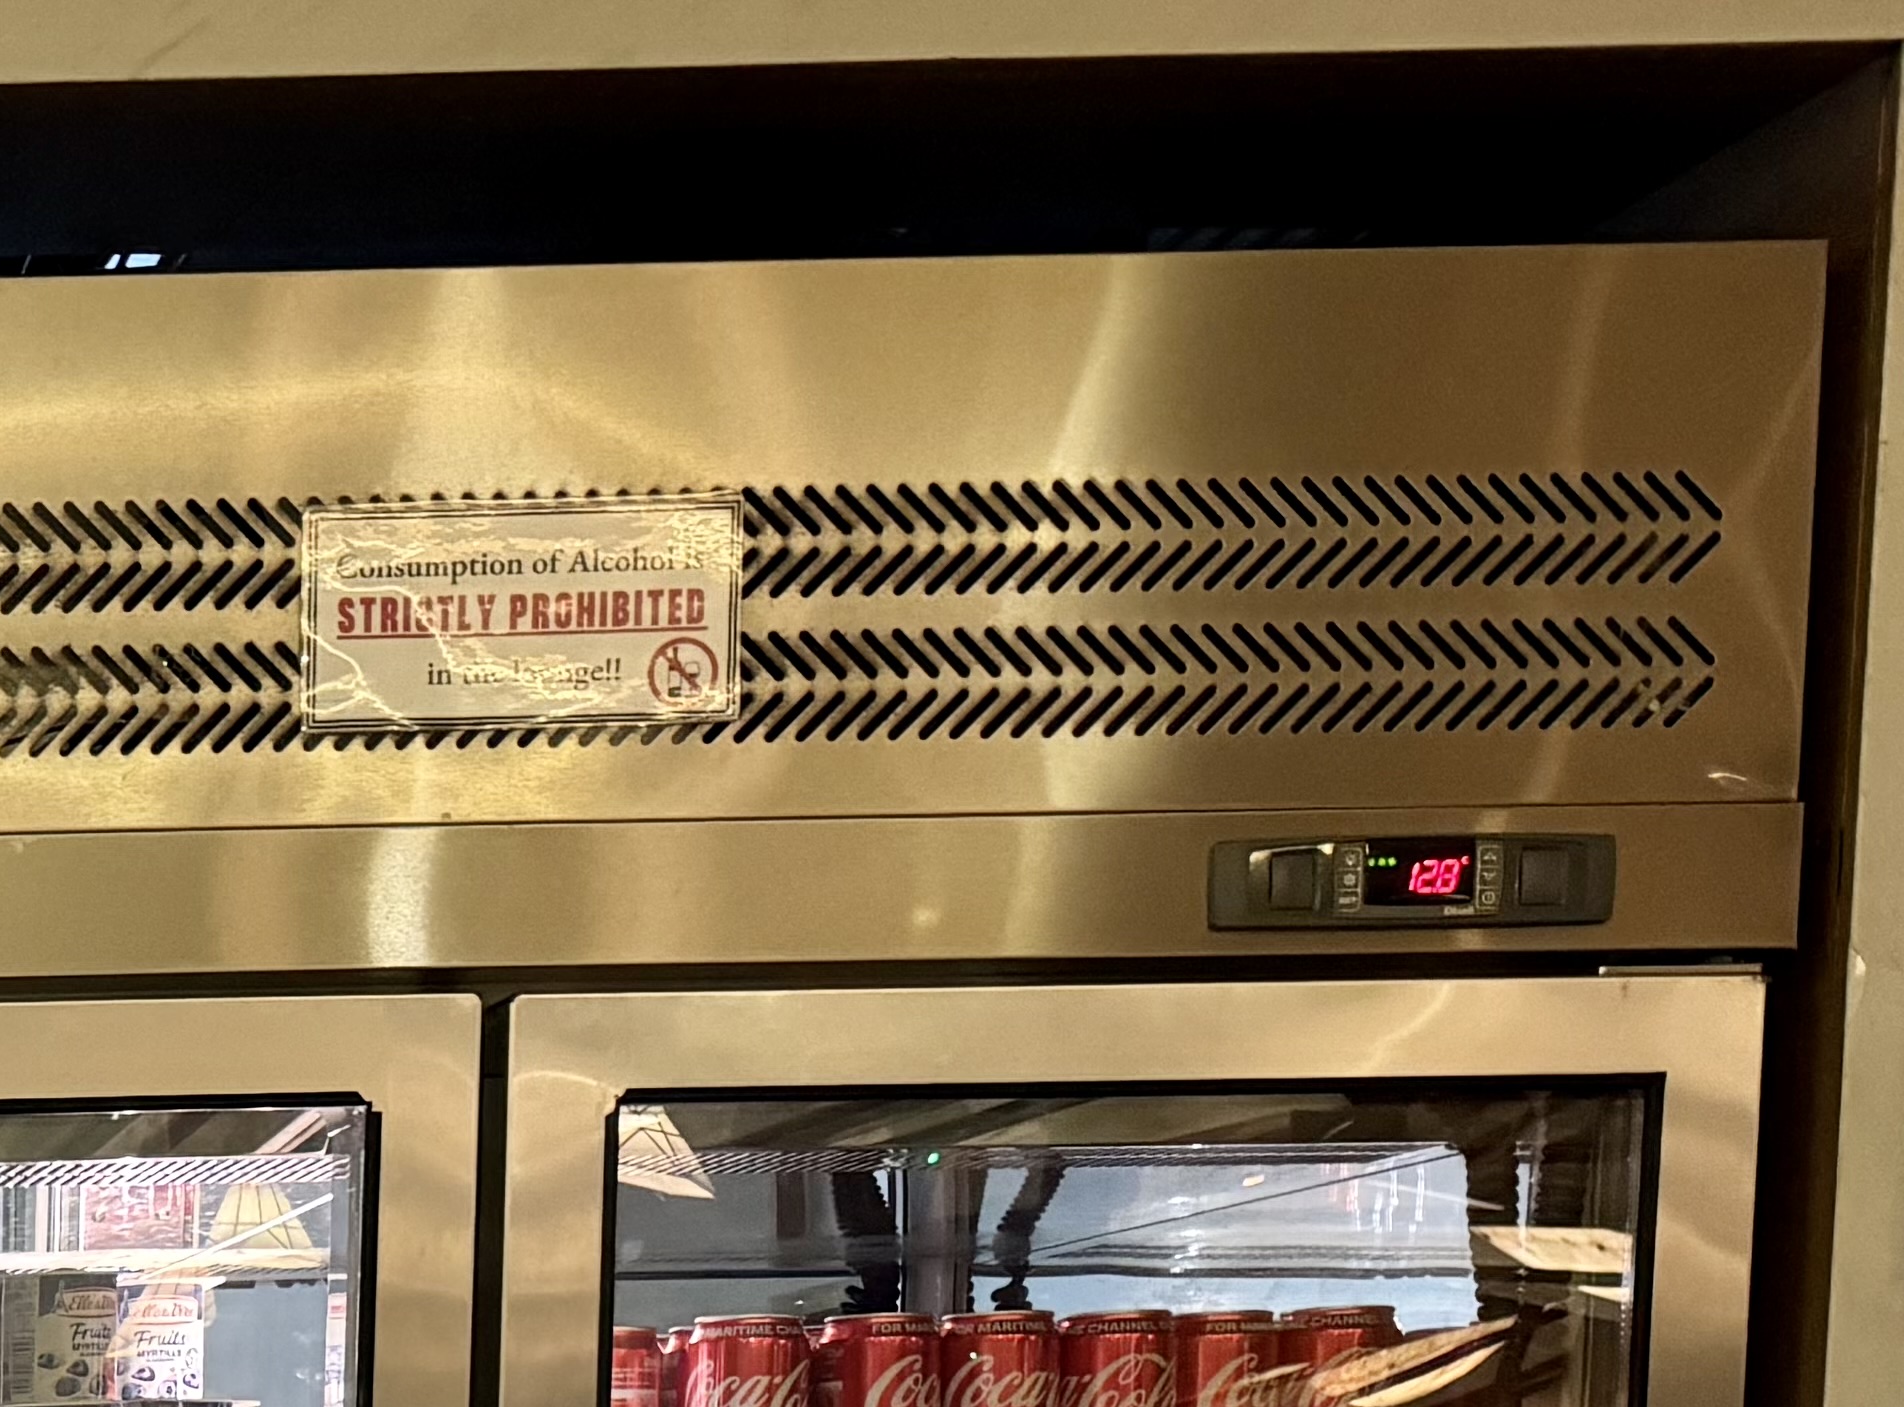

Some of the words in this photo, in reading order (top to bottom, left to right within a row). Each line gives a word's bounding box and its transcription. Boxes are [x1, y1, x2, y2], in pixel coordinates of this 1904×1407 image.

[337, 553, 523, 584] Consumption
[533, 549, 563, 575] of
[567, 547, 675, 574] Alcohol
[337, 595, 497, 633] STRICTLY
[508, 588, 706, 631] PROHIBITED
[427, 662, 452, 685] in
